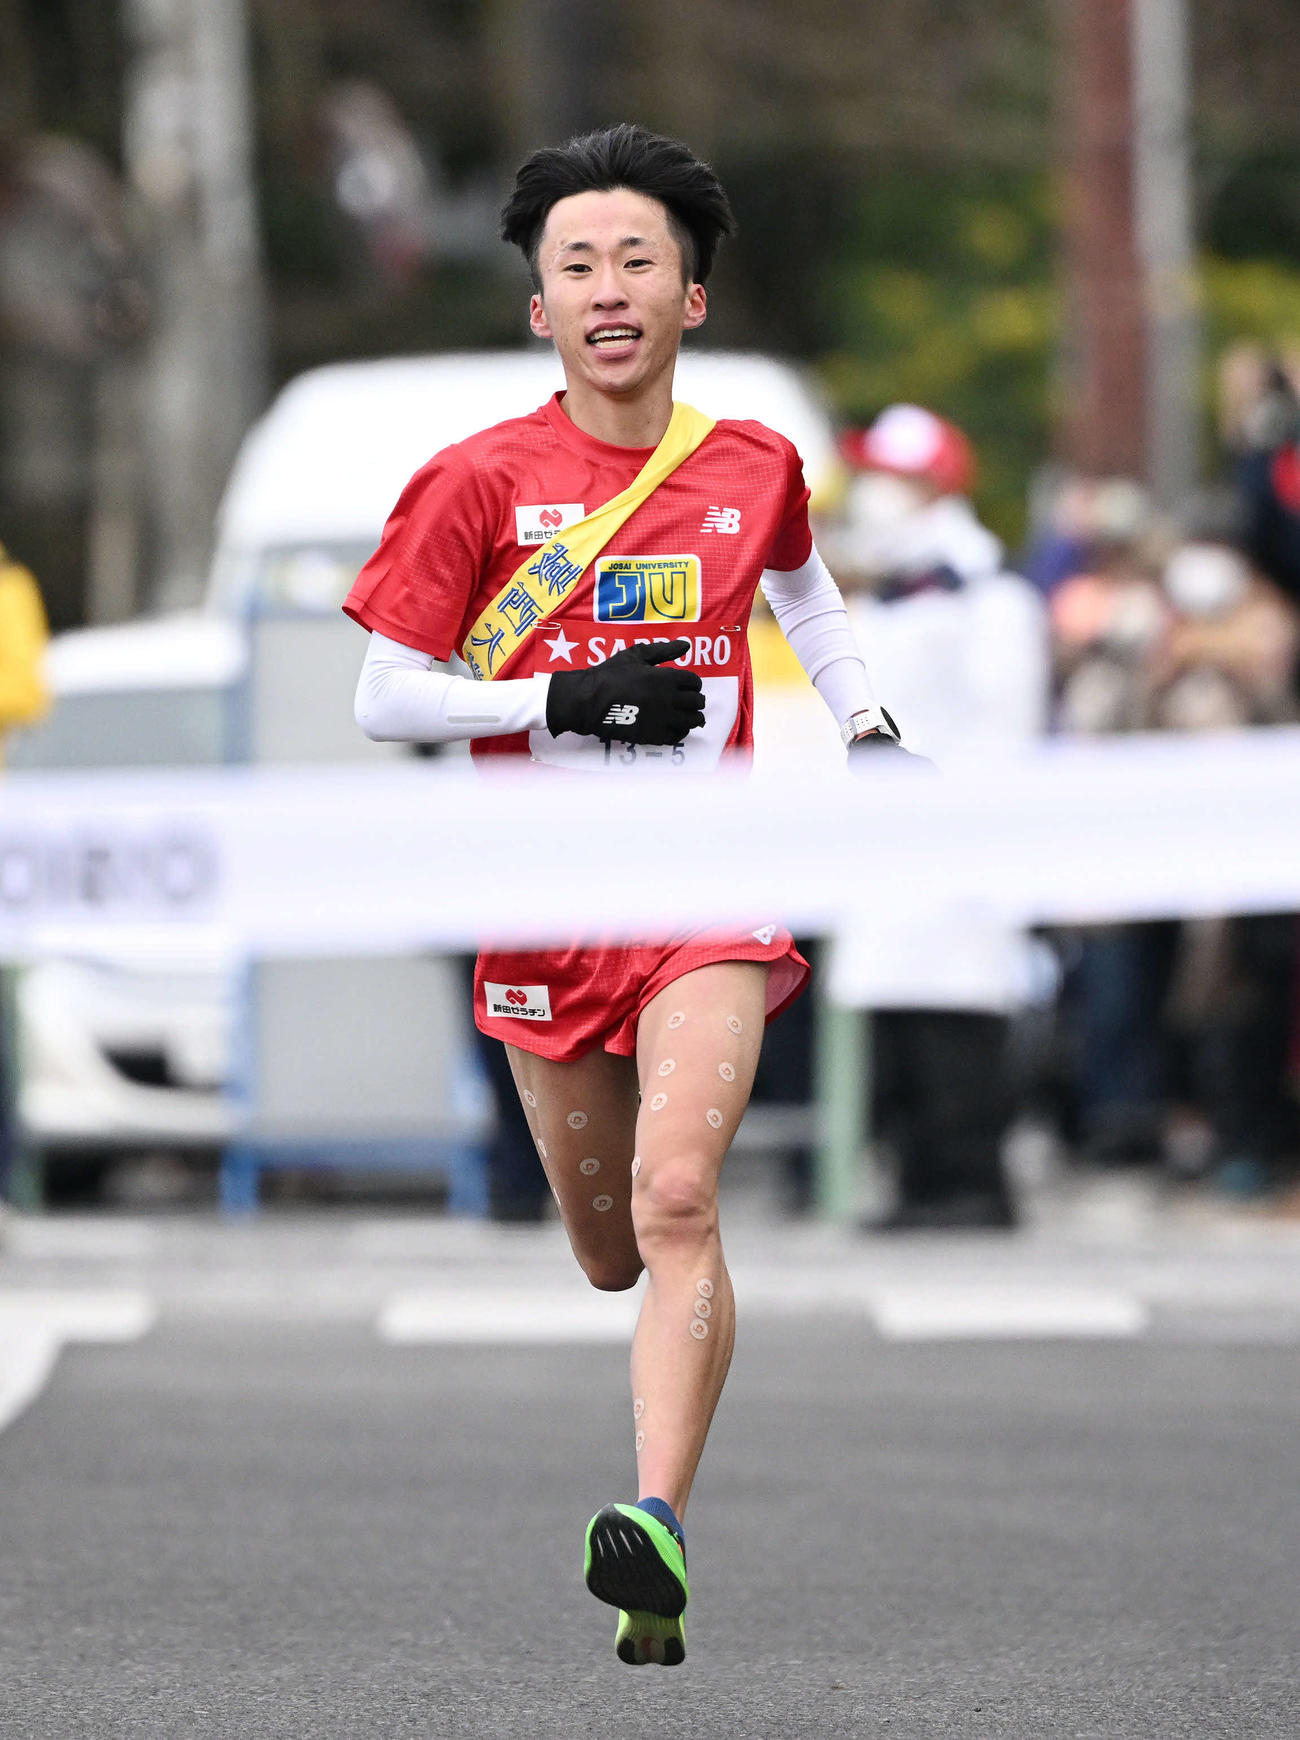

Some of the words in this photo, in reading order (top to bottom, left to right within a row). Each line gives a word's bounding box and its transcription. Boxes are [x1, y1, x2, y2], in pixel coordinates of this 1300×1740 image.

[608, 562, 632, 571] JOSAI
[635, 561, 690, 571] UNIVERSITY
[608, 570, 687, 619] JU
[493, 1003, 546, 1017] 新田ゼラチン
